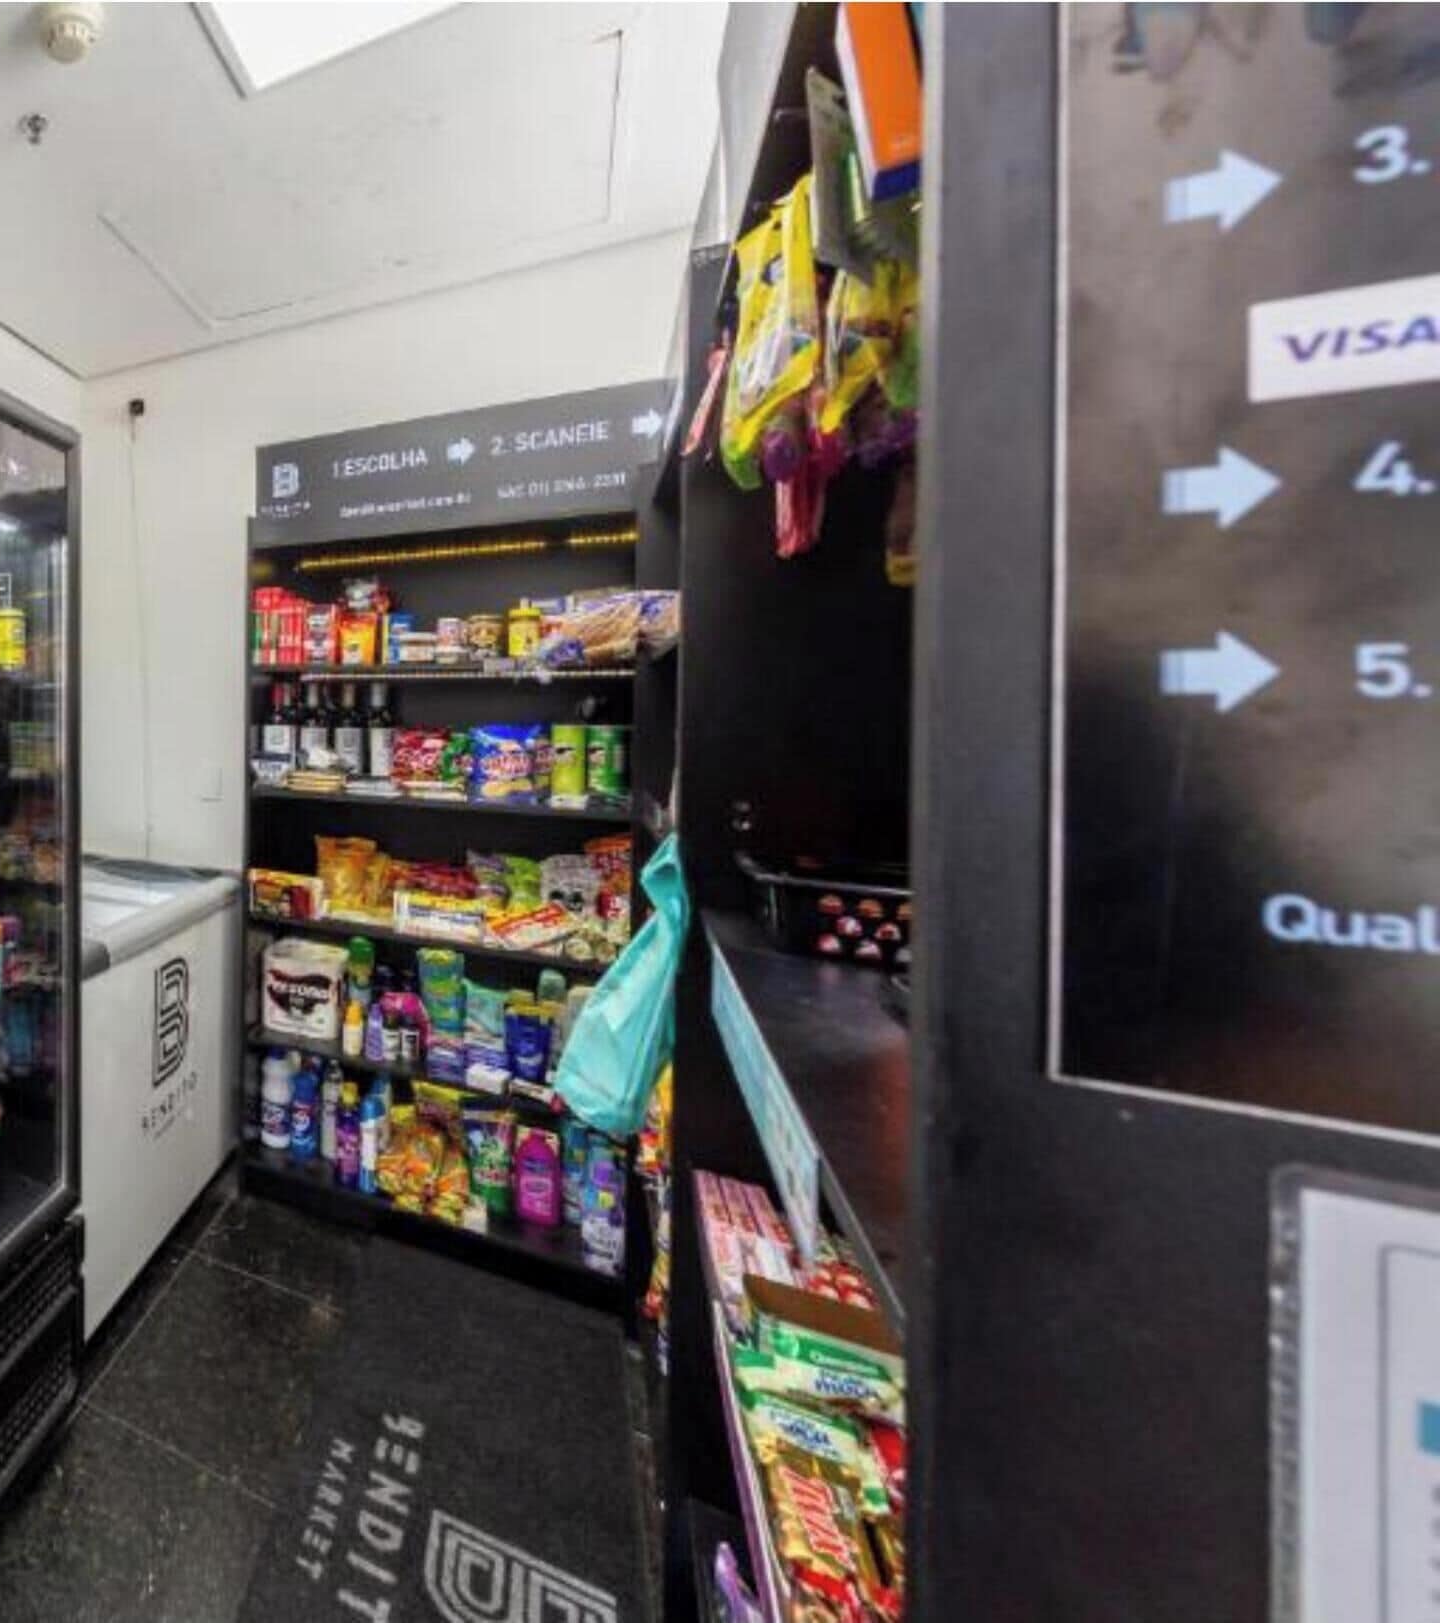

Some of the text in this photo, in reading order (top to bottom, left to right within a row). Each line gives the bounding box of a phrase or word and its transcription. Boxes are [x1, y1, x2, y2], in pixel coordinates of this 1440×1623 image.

[1353, 125, 1431, 184] 3.
[1282, 315, 1440, 363] VISA
[514, 419, 610, 453] SCANEIE
[1353, 440, 1437, 496] 4.
[1354, 642, 1432, 699] 5.
[294, 1437, 357, 1581] MARKET
